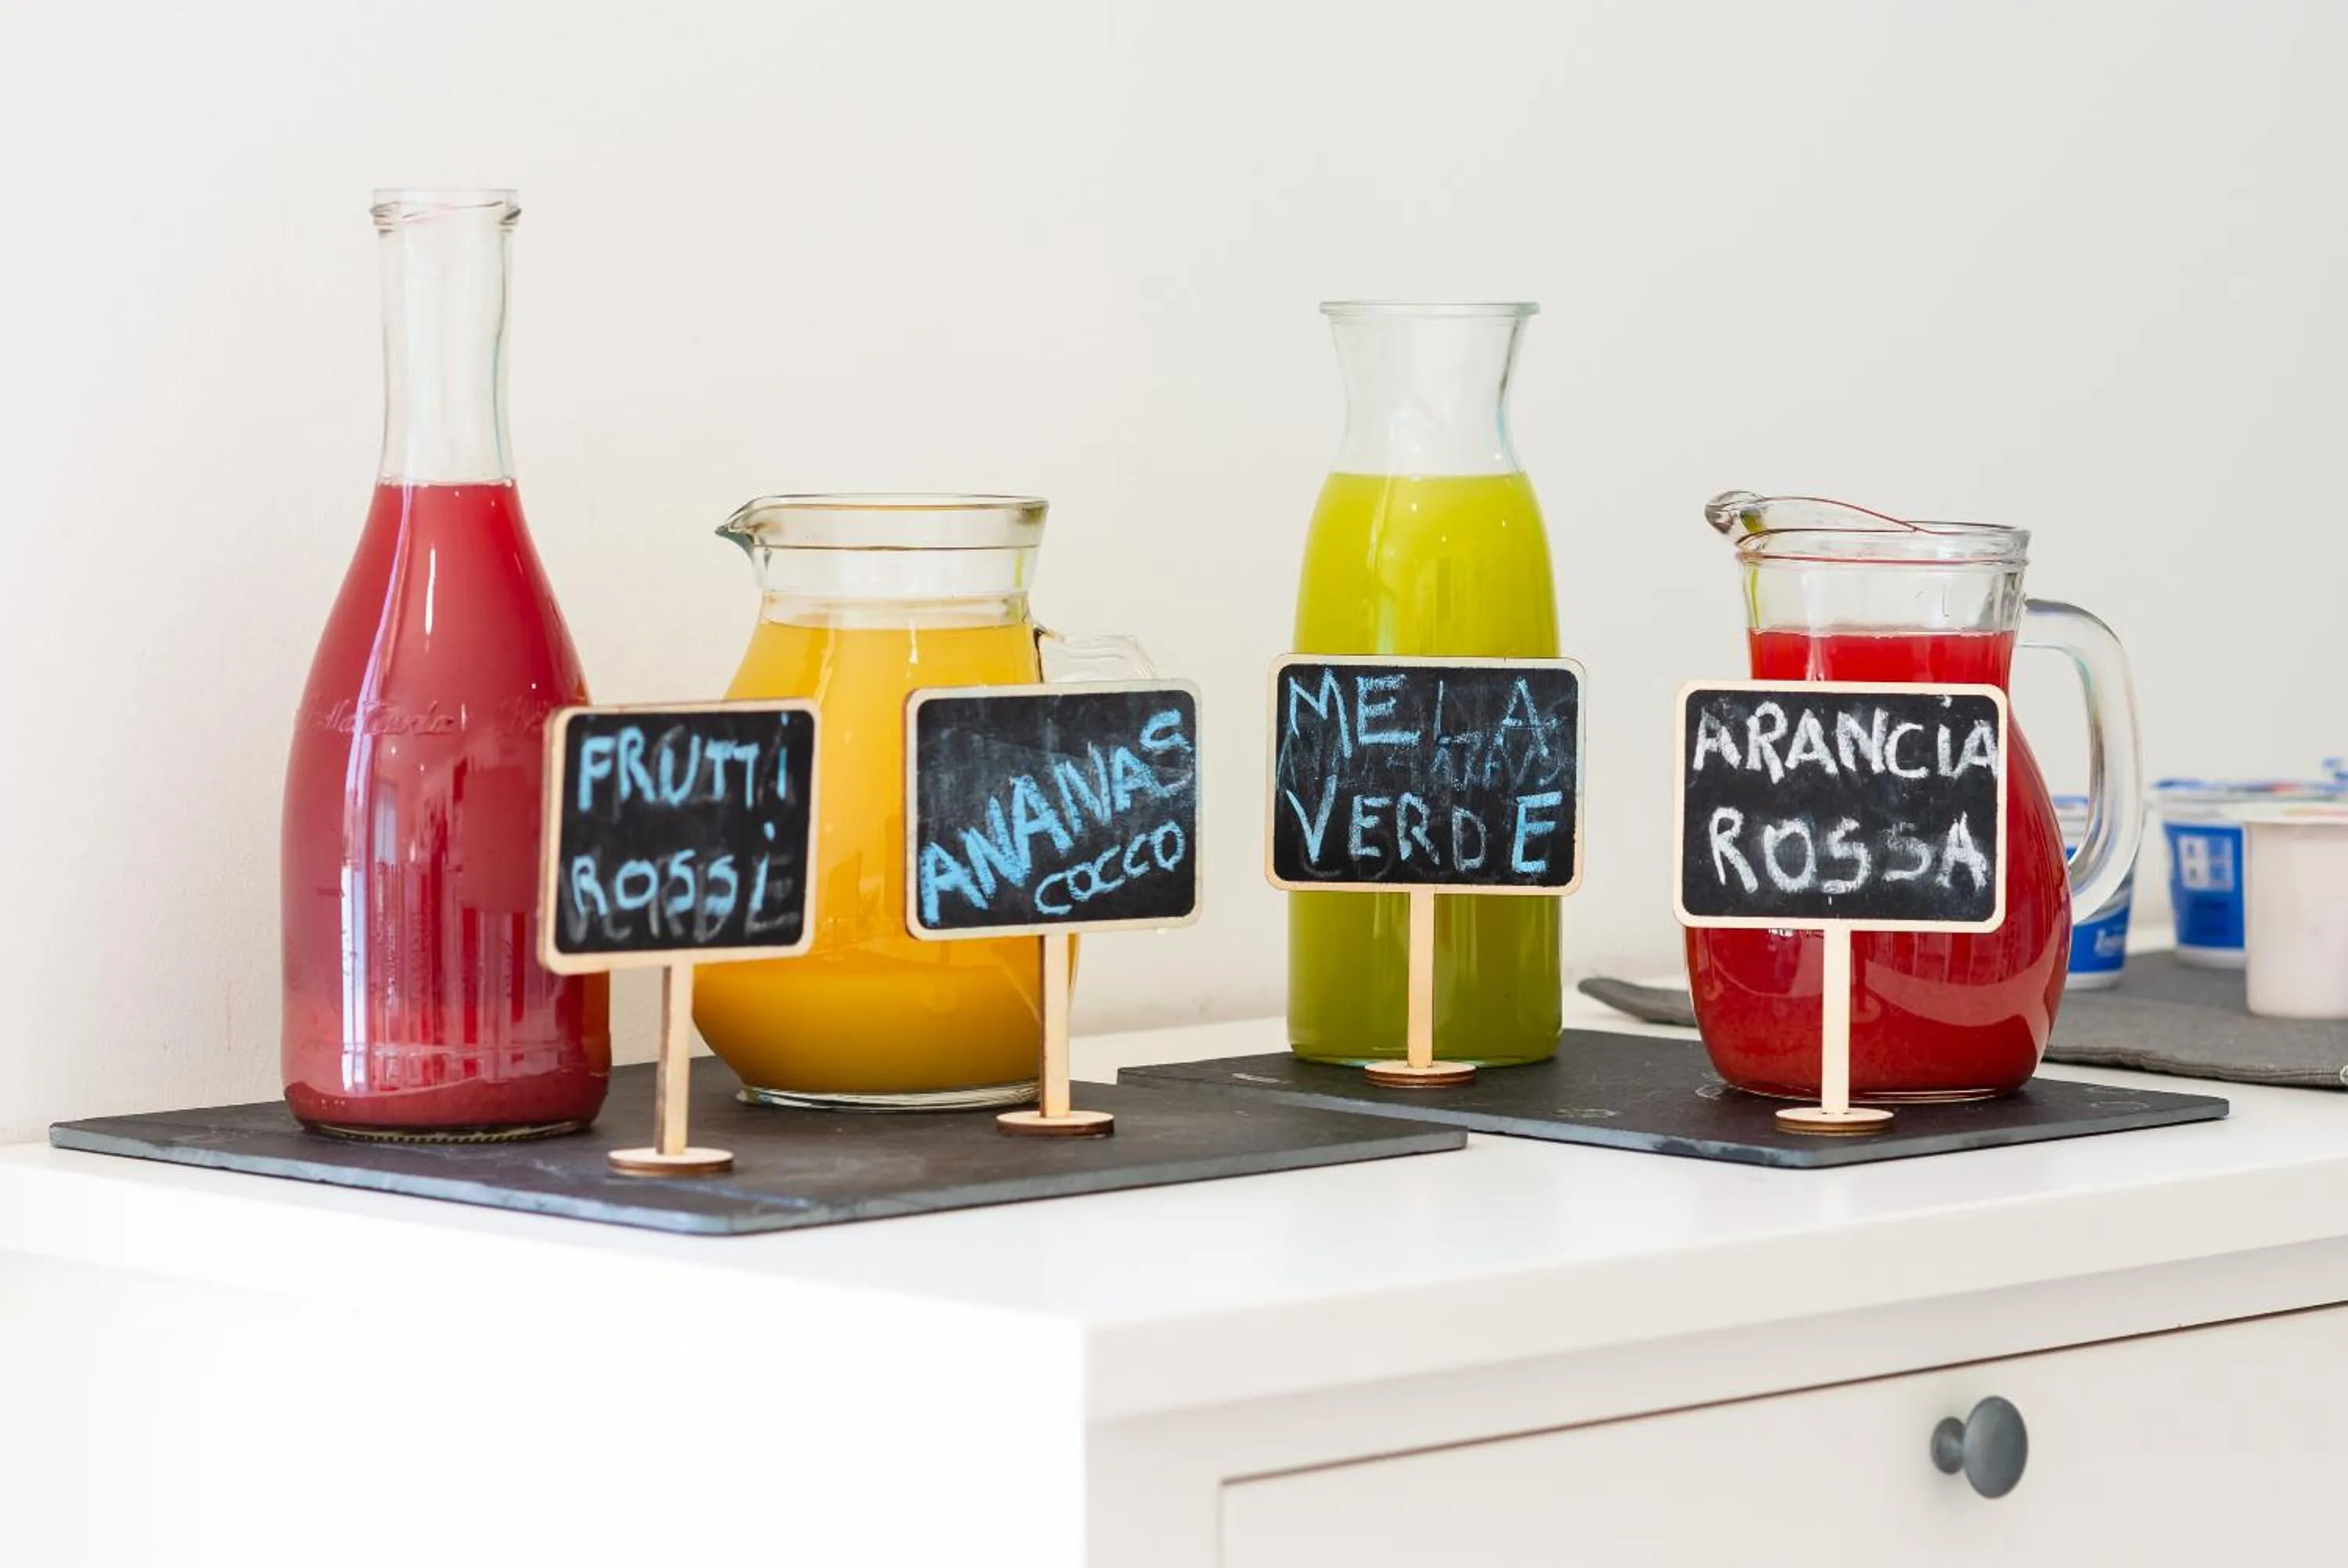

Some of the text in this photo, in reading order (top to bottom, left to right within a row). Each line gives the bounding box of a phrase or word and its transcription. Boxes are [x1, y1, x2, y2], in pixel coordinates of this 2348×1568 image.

[1288, 667, 1549, 759] MELA
[920, 709, 1194, 925] ANANAS
[1286, 775, 1563, 873] VERDE
[1708, 807, 1989, 894] ROSSA
[1034, 821, 1186, 915] COCCO
